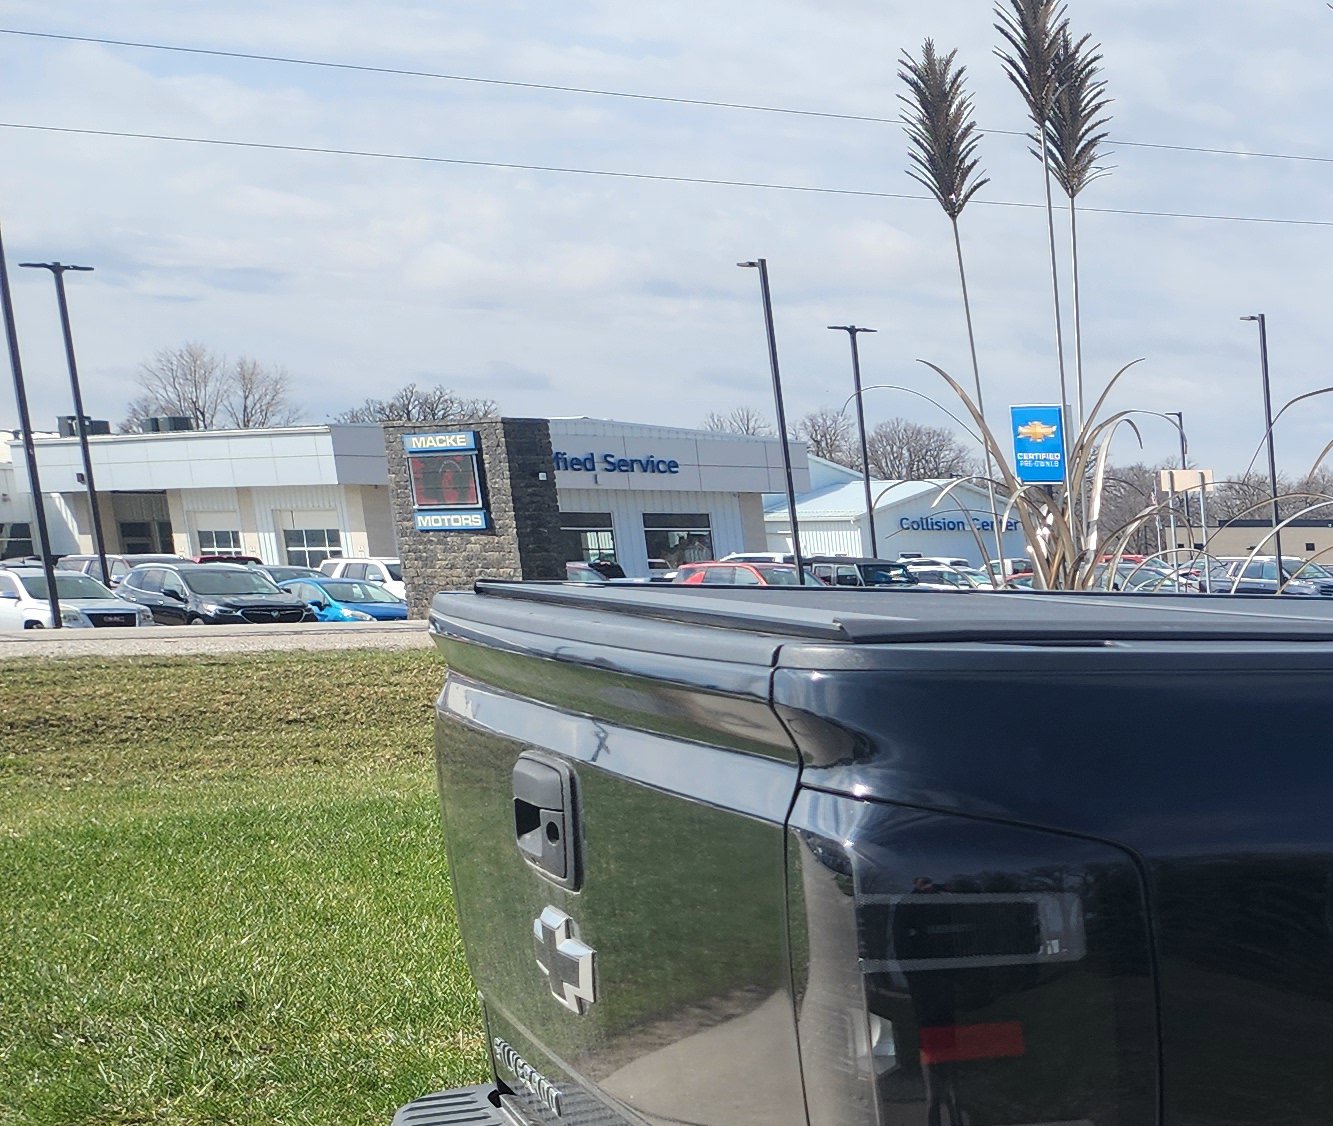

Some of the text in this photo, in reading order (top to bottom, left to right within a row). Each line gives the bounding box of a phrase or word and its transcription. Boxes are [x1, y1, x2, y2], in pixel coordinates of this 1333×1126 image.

[411, 435, 467, 448] MACKE
[1017, 452, 1061, 460] CERTIFIED
[603, 453, 680, 474] Service
[417, 514, 482, 527] MOTORS
[899, 517, 965, 531] Collision
